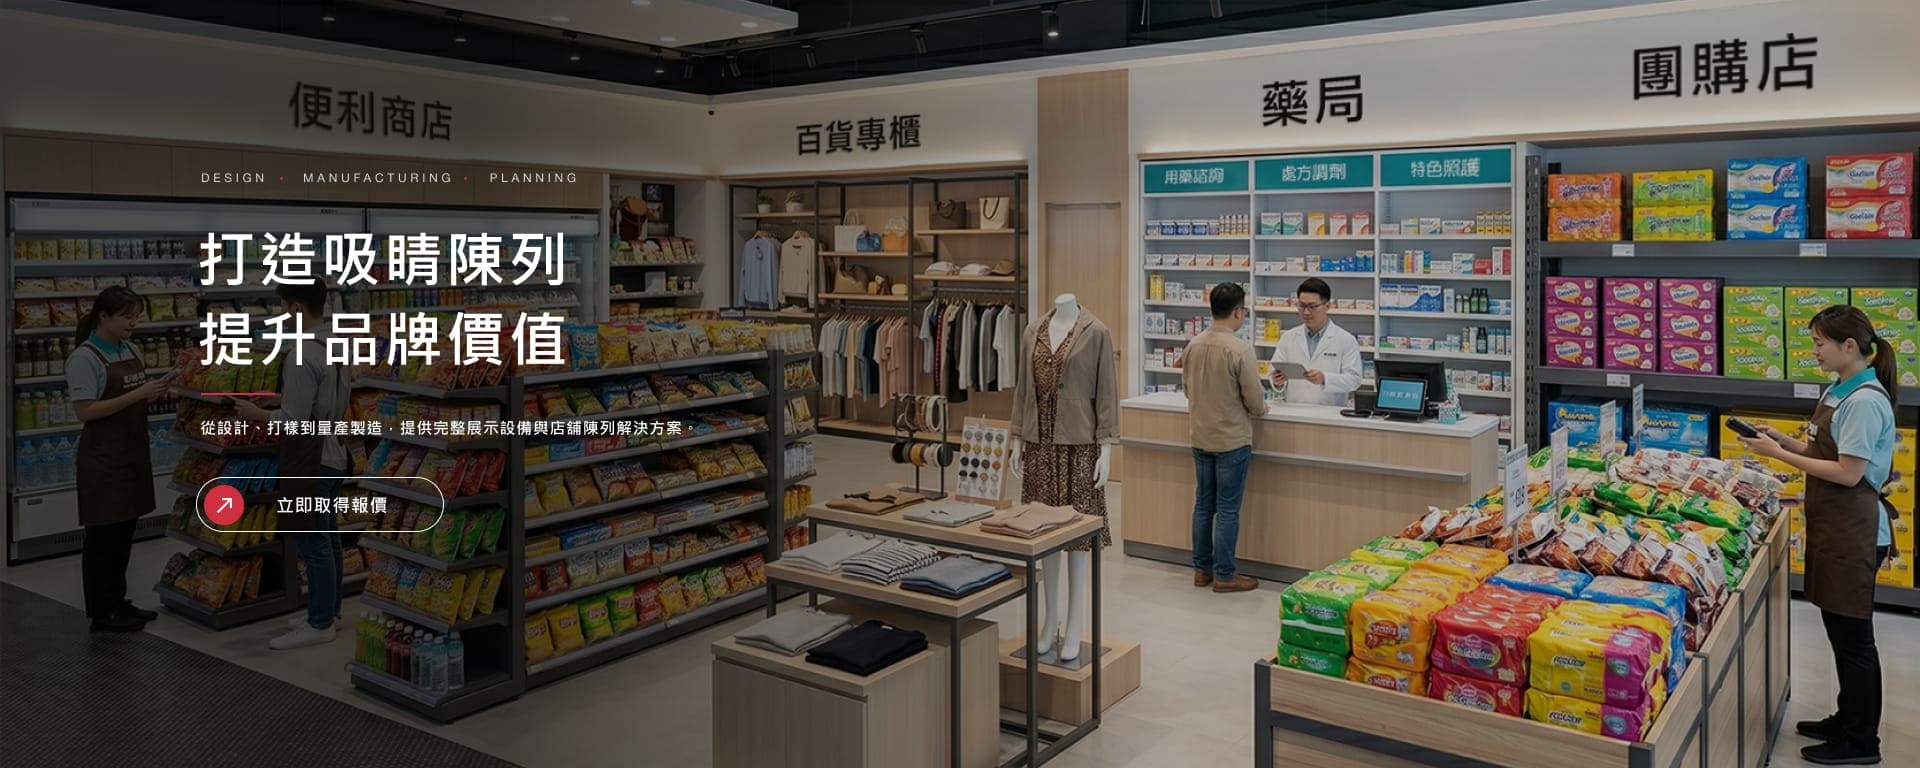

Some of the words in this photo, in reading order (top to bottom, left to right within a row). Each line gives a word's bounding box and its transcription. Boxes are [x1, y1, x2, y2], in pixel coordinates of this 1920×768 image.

[1633, 32, 1819, 100] 團購店
[289, 81, 453, 141] 便利商店
[1262, 74, 1364, 127] 藥局
[796, 114, 921, 156] 百貨專櫃
[1164, 167, 1225, 185] 用藥諮詢
[1281, 162, 1347, 182] 處方調劑
[1410, 157, 1480, 178] 特色照護
